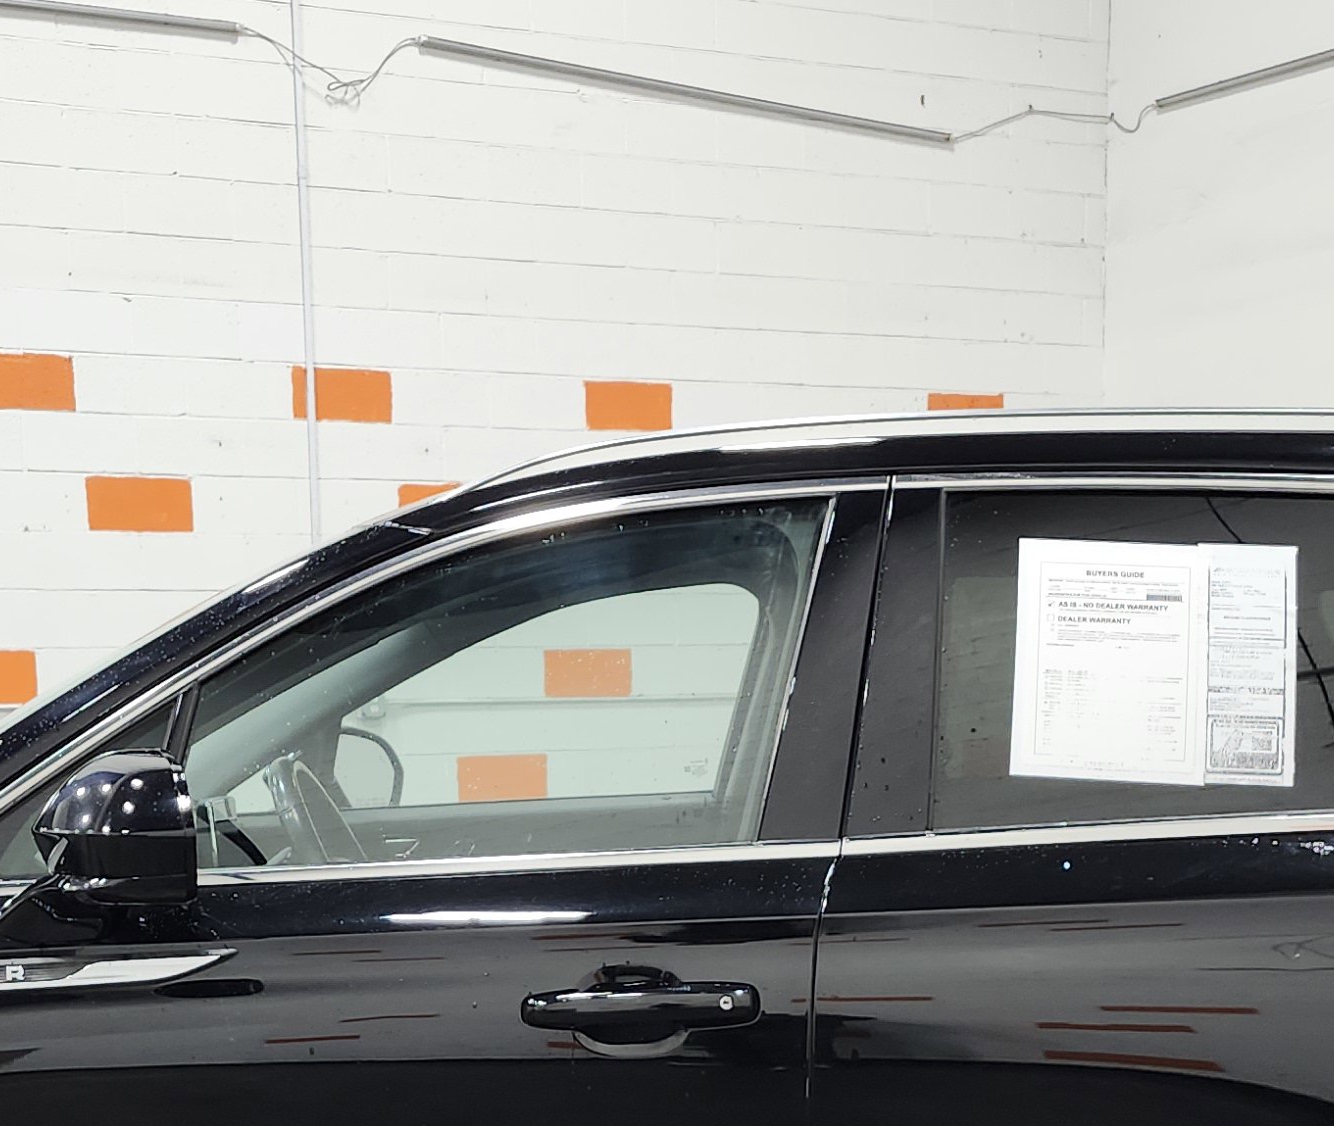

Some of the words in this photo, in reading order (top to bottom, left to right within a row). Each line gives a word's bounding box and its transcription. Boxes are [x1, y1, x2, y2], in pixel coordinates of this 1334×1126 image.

[1085, 569, 1119, 578] BUYERS
[1120, 571, 1145, 579] GUIDE
[1058, 600, 1069, 608] AS
[1095, 602, 1126, 610] DEALER
[1127, 602, 1169, 612] WARRANTY
[1057, 615, 1088, 623] DEALER
[1089, 616, 1132, 625] WARRANTY
